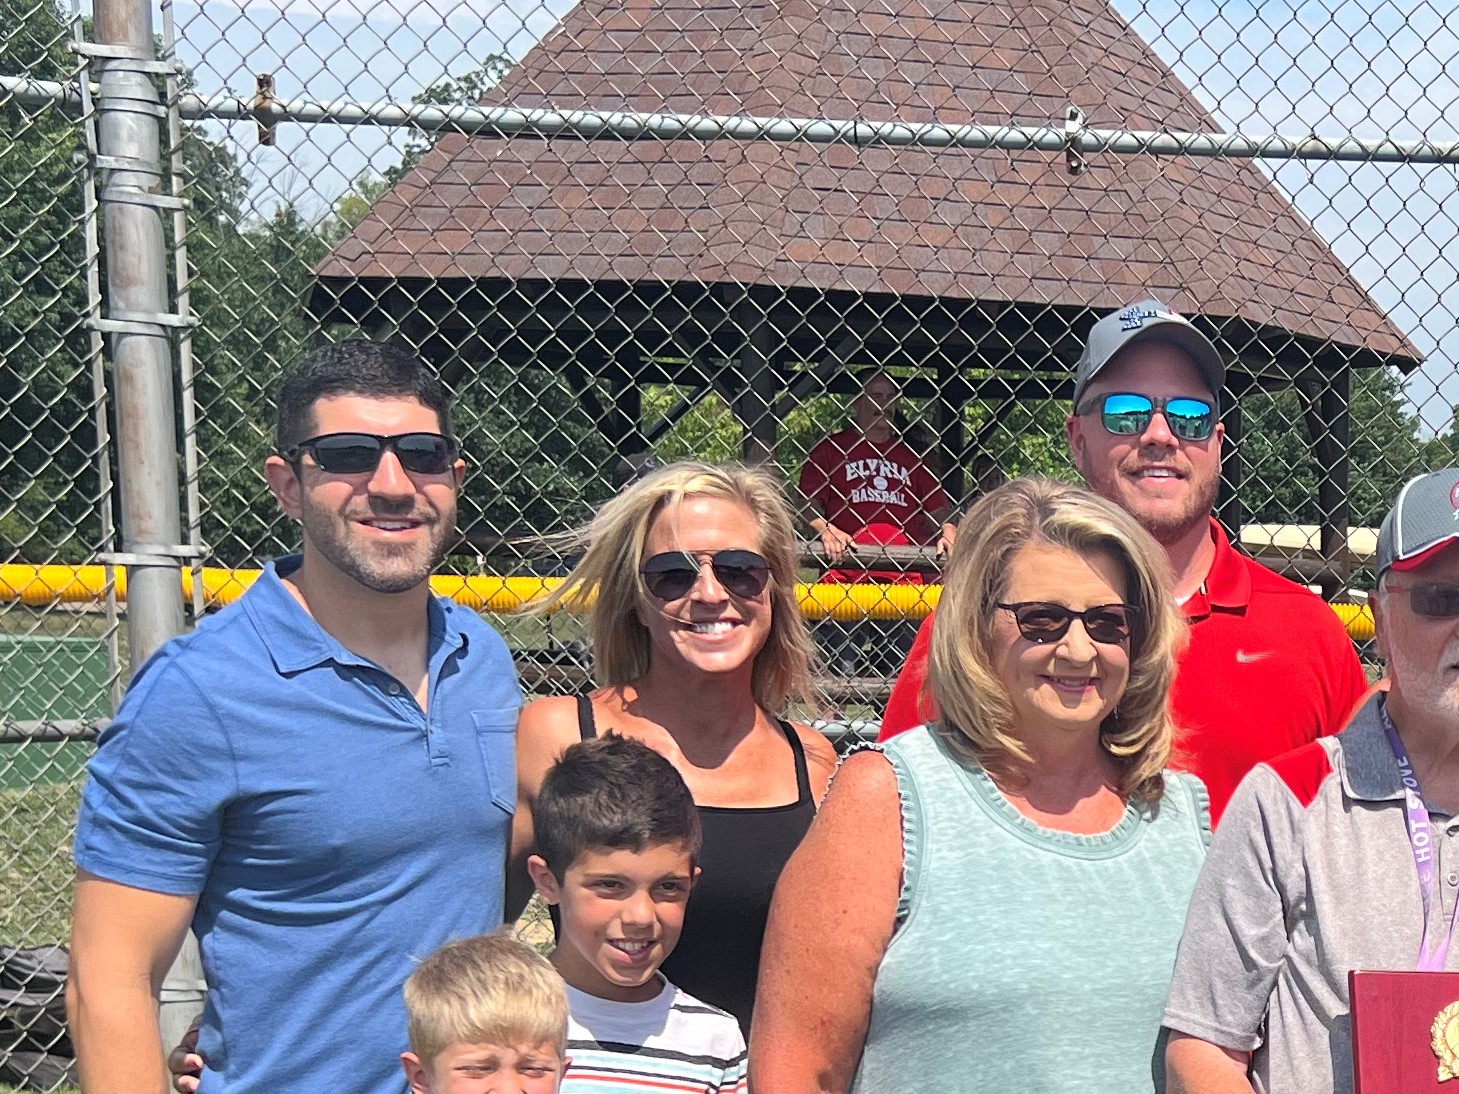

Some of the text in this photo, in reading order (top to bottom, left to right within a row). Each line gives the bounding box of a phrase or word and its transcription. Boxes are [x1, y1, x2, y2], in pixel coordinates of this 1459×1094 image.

[845, 458, 912, 487] ELYRIA
[851, 489, 908, 507] BASEBALL
[1411, 819, 1432, 863] HOT
